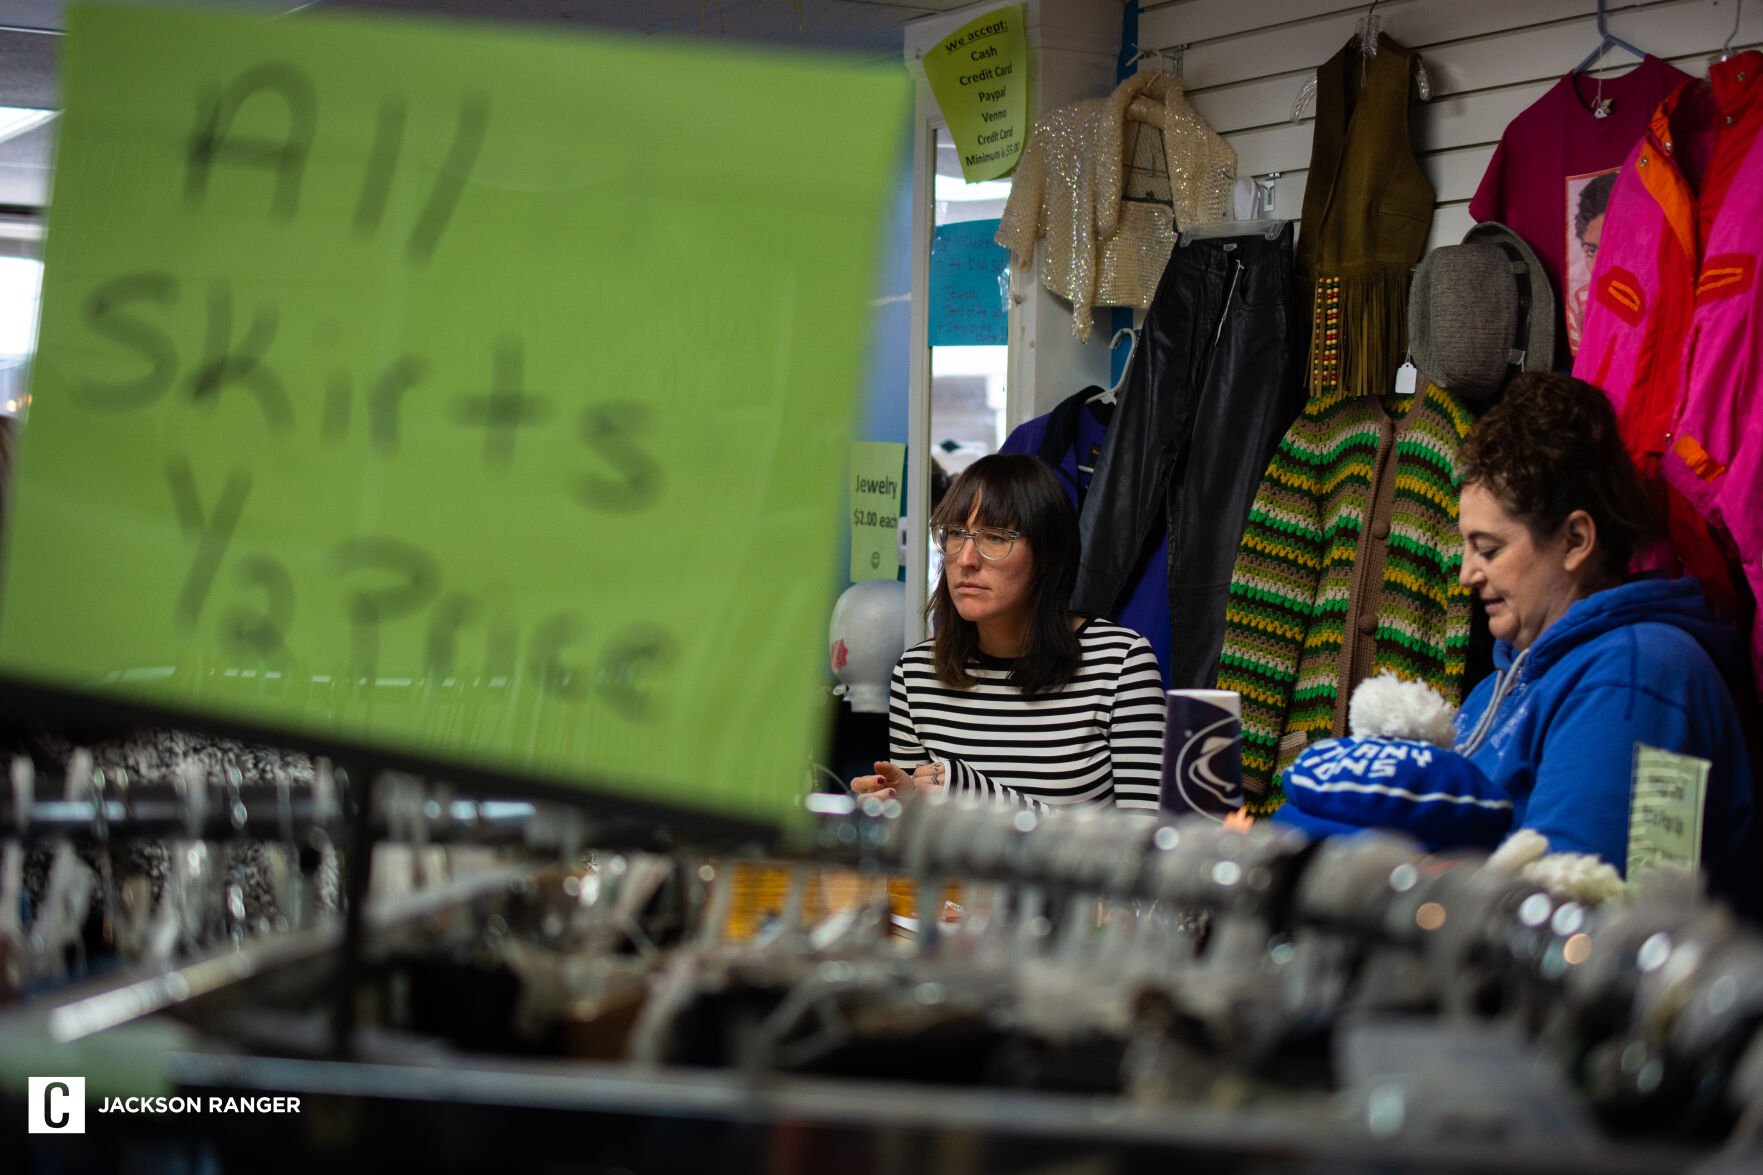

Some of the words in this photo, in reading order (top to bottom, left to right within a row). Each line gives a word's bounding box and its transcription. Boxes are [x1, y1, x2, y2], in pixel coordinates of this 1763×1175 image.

[945, 38, 966, 54] We
[968, 20, 1008, 43] accept:
[970, 46, 998, 62] Cash
[959, 69, 993, 87] Credit
[994, 63, 1013, 78] Card
[978, 86, 1007, 103] Paypal
[981, 109, 1007, 124] Venmo
[977, 131, 999, 145] Credit
[1000, 126, 1014, 140] Card
[183, 57, 492, 266] All
[965, 152, 1000, 167] Minimum
[855, 474, 898, 500] Jewelry
[853, 508, 878, 527] $2.00
[879, 514, 898, 529] each
[329, 534, 682, 728] Price
